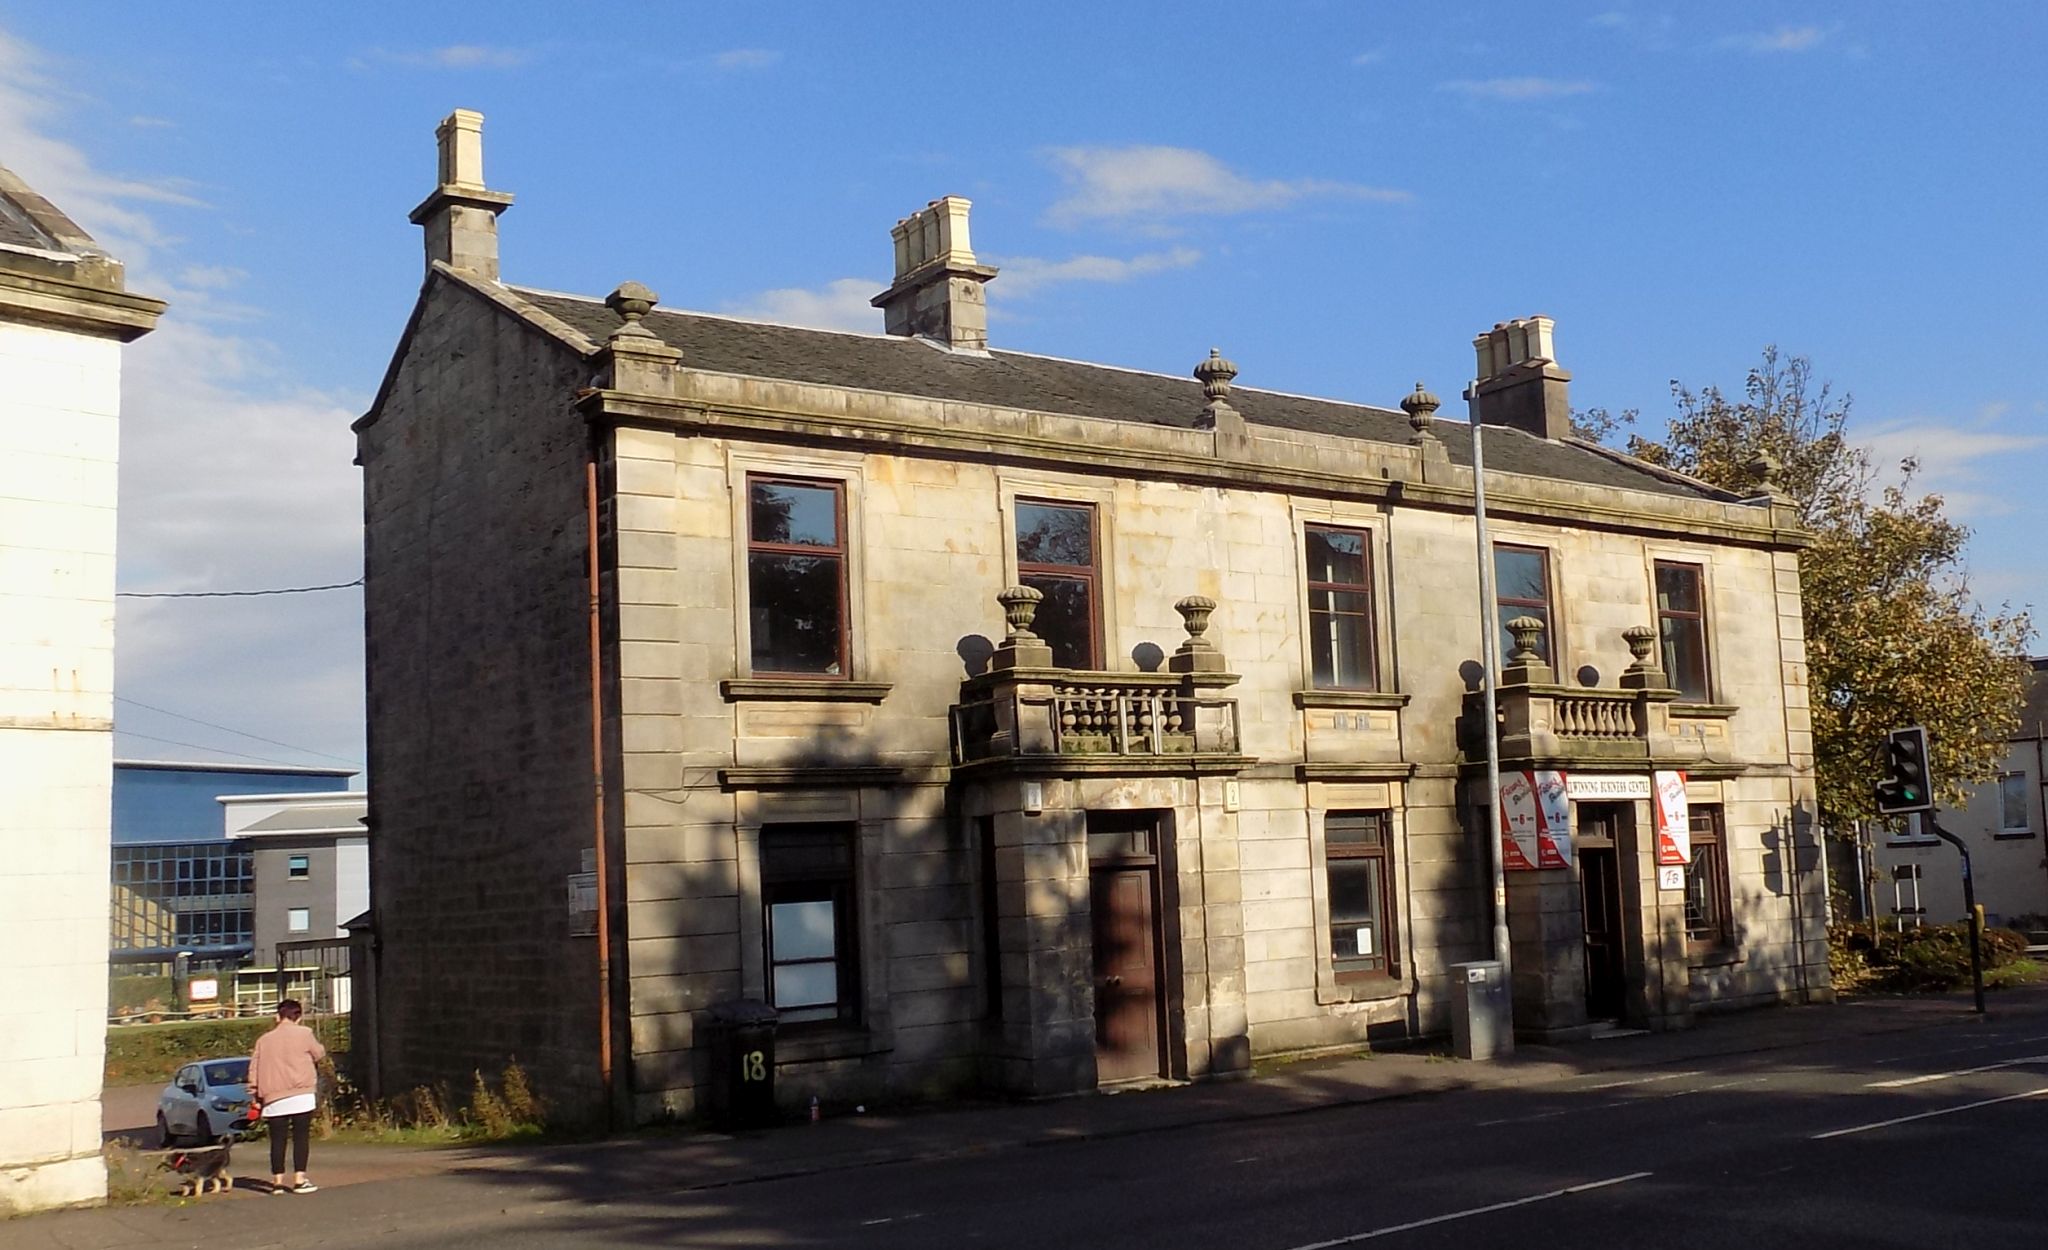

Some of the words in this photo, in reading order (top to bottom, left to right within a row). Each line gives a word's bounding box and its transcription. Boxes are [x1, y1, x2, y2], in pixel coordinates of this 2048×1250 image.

[1567, 781, 1598, 793] ILWINNING
[1600, 781, 1627, 793] BUSINESS
[1629, 781, 1649, 793] CENTRE
[743, 1051, 766, 1082] 18
